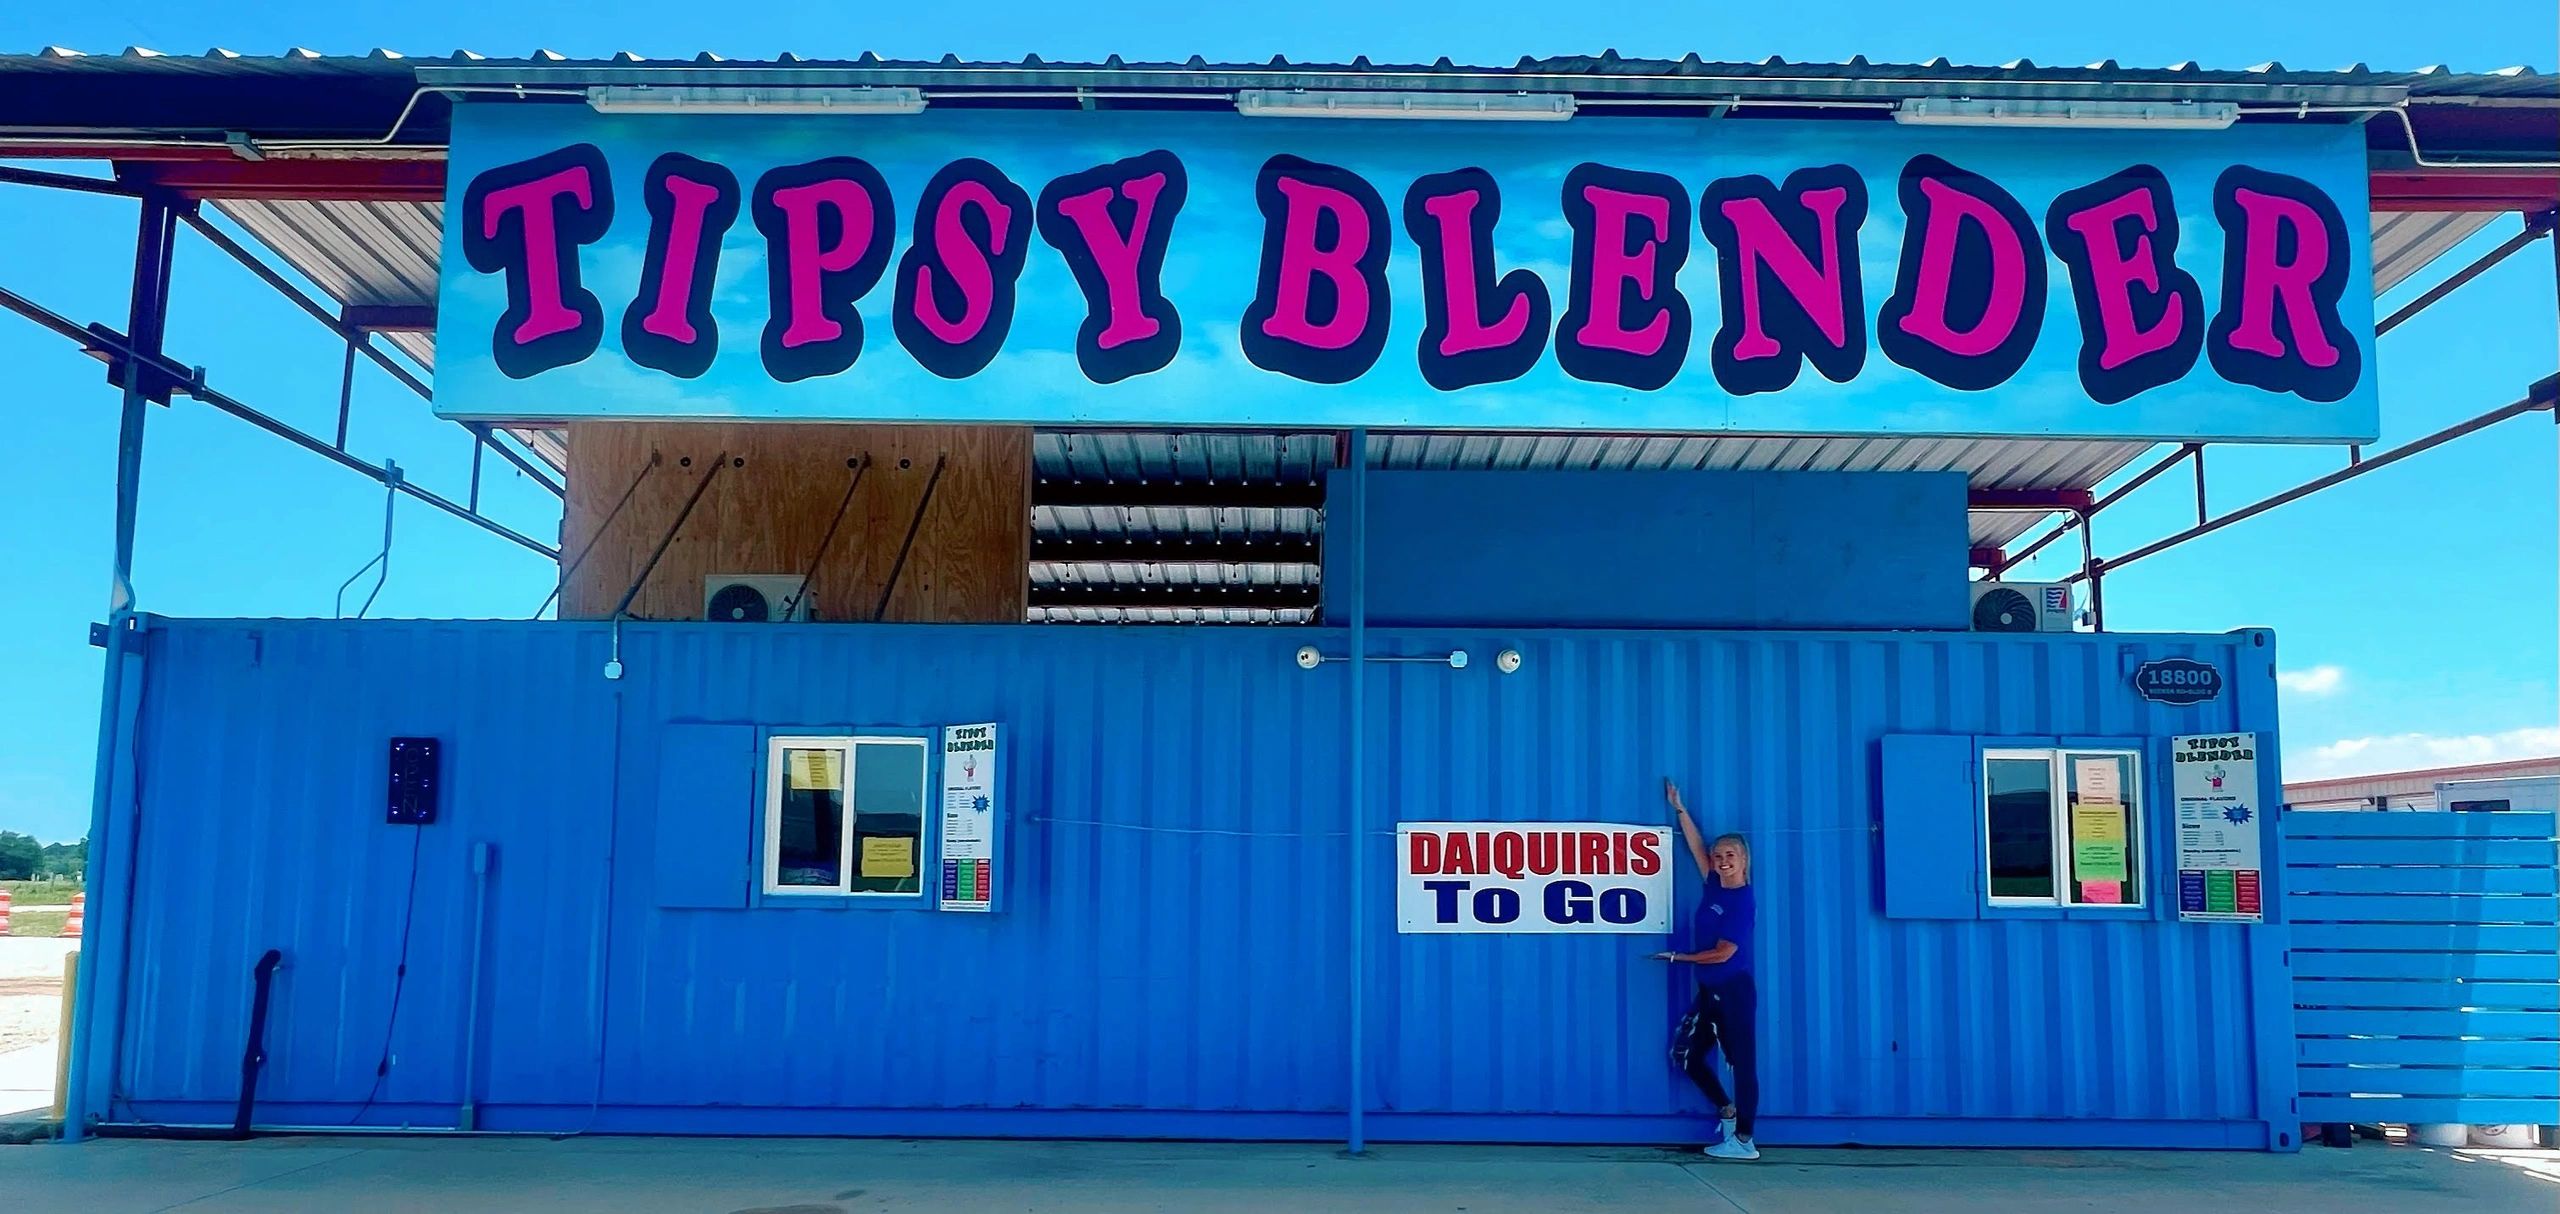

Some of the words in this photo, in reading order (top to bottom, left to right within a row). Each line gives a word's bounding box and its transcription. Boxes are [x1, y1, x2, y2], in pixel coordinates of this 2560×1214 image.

[1193, 76, 1301, 87] MEXICO
[472, 153, 1178, 372] TIPSY
[1250, 162, 2350, 393] BLENDER
[2148, 669, 2213, 685] 18800
[2187, 737, 2240, 749] TIPSY
[2175, 749, 2254, 762] BLENDER
[1409, 831, 1661, 880] DAIQUIRIS
[1423, 880, 1521, 924] To
[1543, 880, 1647, 925] Go
